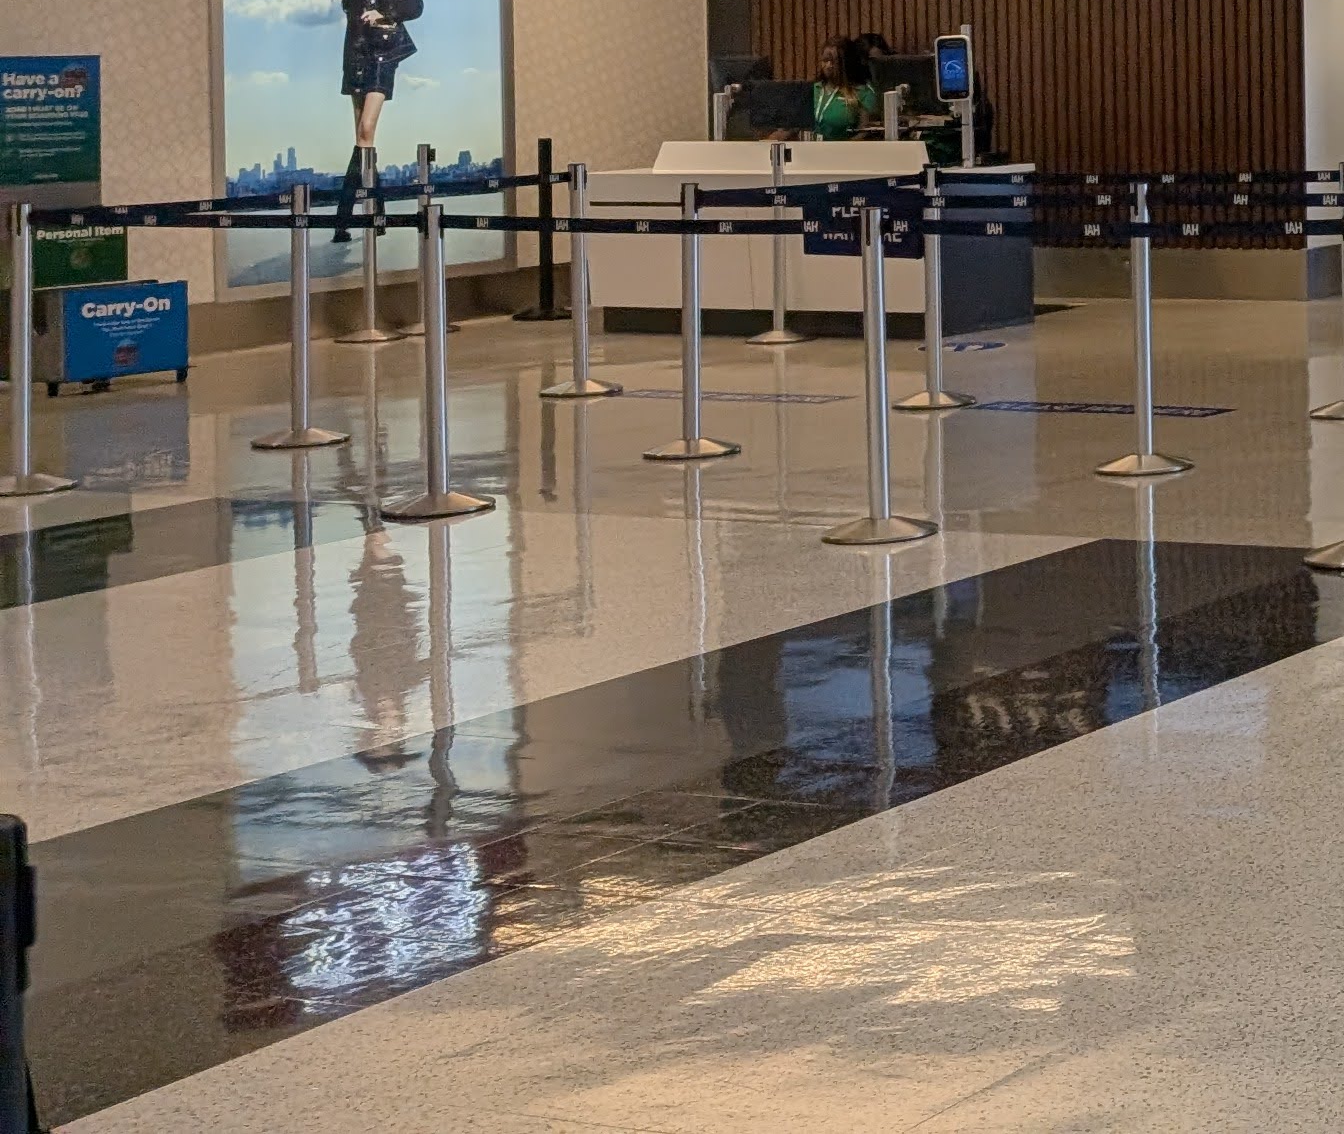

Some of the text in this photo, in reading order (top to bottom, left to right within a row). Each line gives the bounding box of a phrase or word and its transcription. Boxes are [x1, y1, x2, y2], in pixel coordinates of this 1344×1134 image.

[2, 72, 59, 86] Have a
[3, 84, 84, 101] carry-on?
[852, 197, 866, 206] IAH
[1013, 197, 1027, 206] IAH
[1097, 195, 1111, 205] IAH
[1233, 194, 1248, 205] IAH
[1322, 194, 1338, 205] IAH
[831, 206, 890, 218] PLEE
[373, 217, 387, 226] IAH
[475, 218, 489, 227] IAH
[555, 220, 569, 230] IAH
[803, 221, 819, 232] IAH
[893, 220, 909, 232] IAH
[36, 225, 92, 241] Personal
[94, 225, 124, 237] Item
[719, 223, 733, 233] IAH
[986, 223, 1003, 235] IAH
[1085, 224, 1100, 236] IAH
[1182, 224, 1199, 236] IAH
[1284, 222, 1303, 234] IAH
[81, 296, 171, 318] Carry-On
